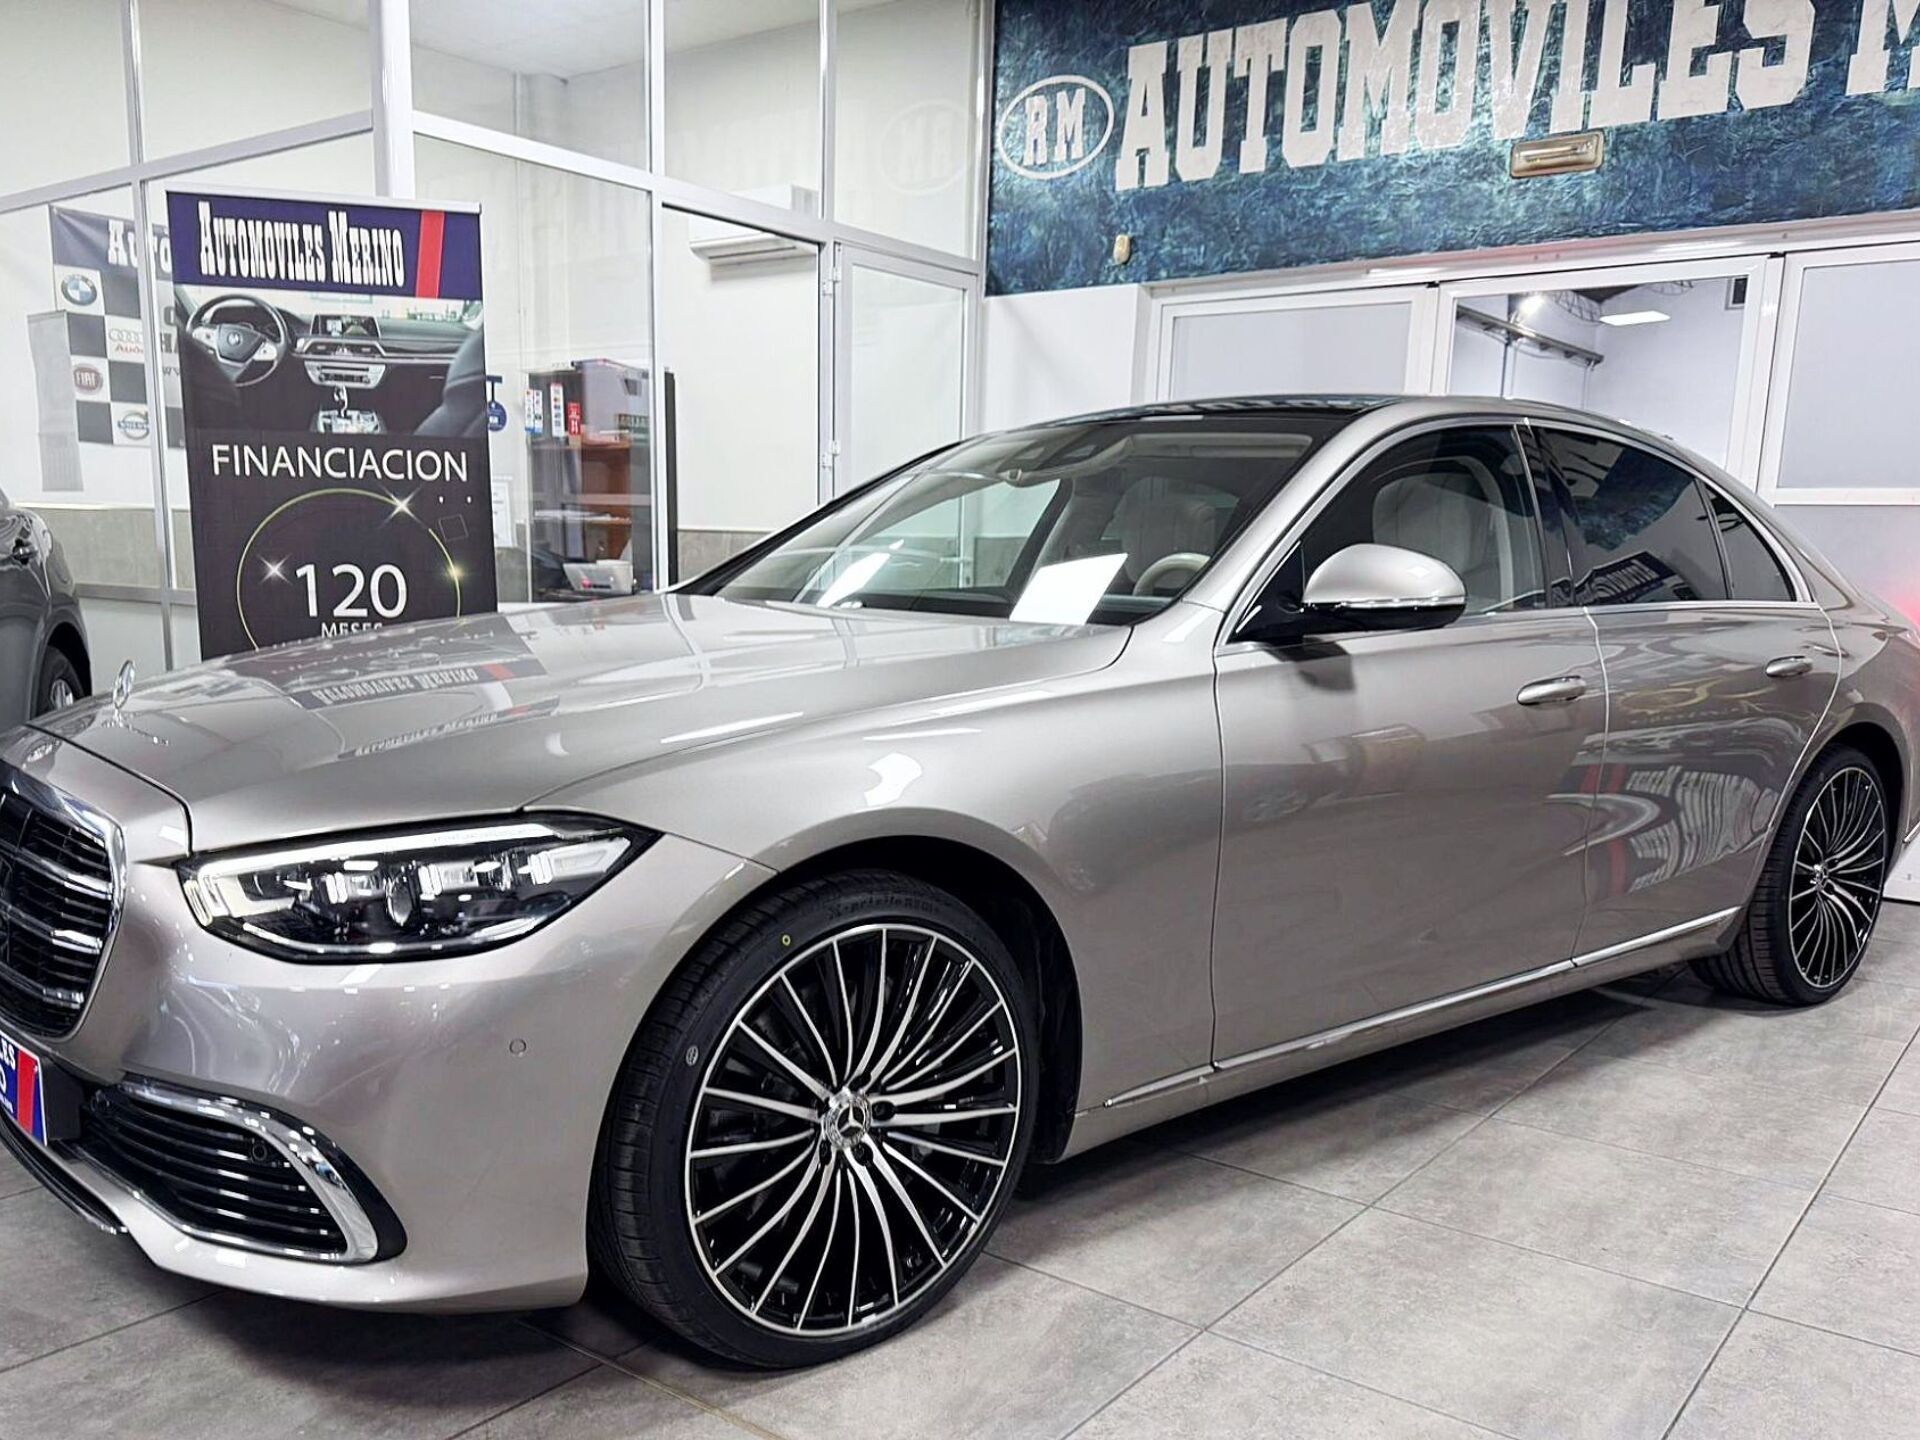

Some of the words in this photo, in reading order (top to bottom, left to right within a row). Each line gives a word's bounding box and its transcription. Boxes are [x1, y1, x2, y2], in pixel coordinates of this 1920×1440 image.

[1023, 87, 1087, 168] RM
[1115, 0, 1815, 191] AUTOMOVILES
[197, 200, 327, 283] AUTOMOVILES
[327, 210, 405, 288] MERINO
[211, 444, 468, 482] FINANCIACION
[295, 563, 408, 618] 120
